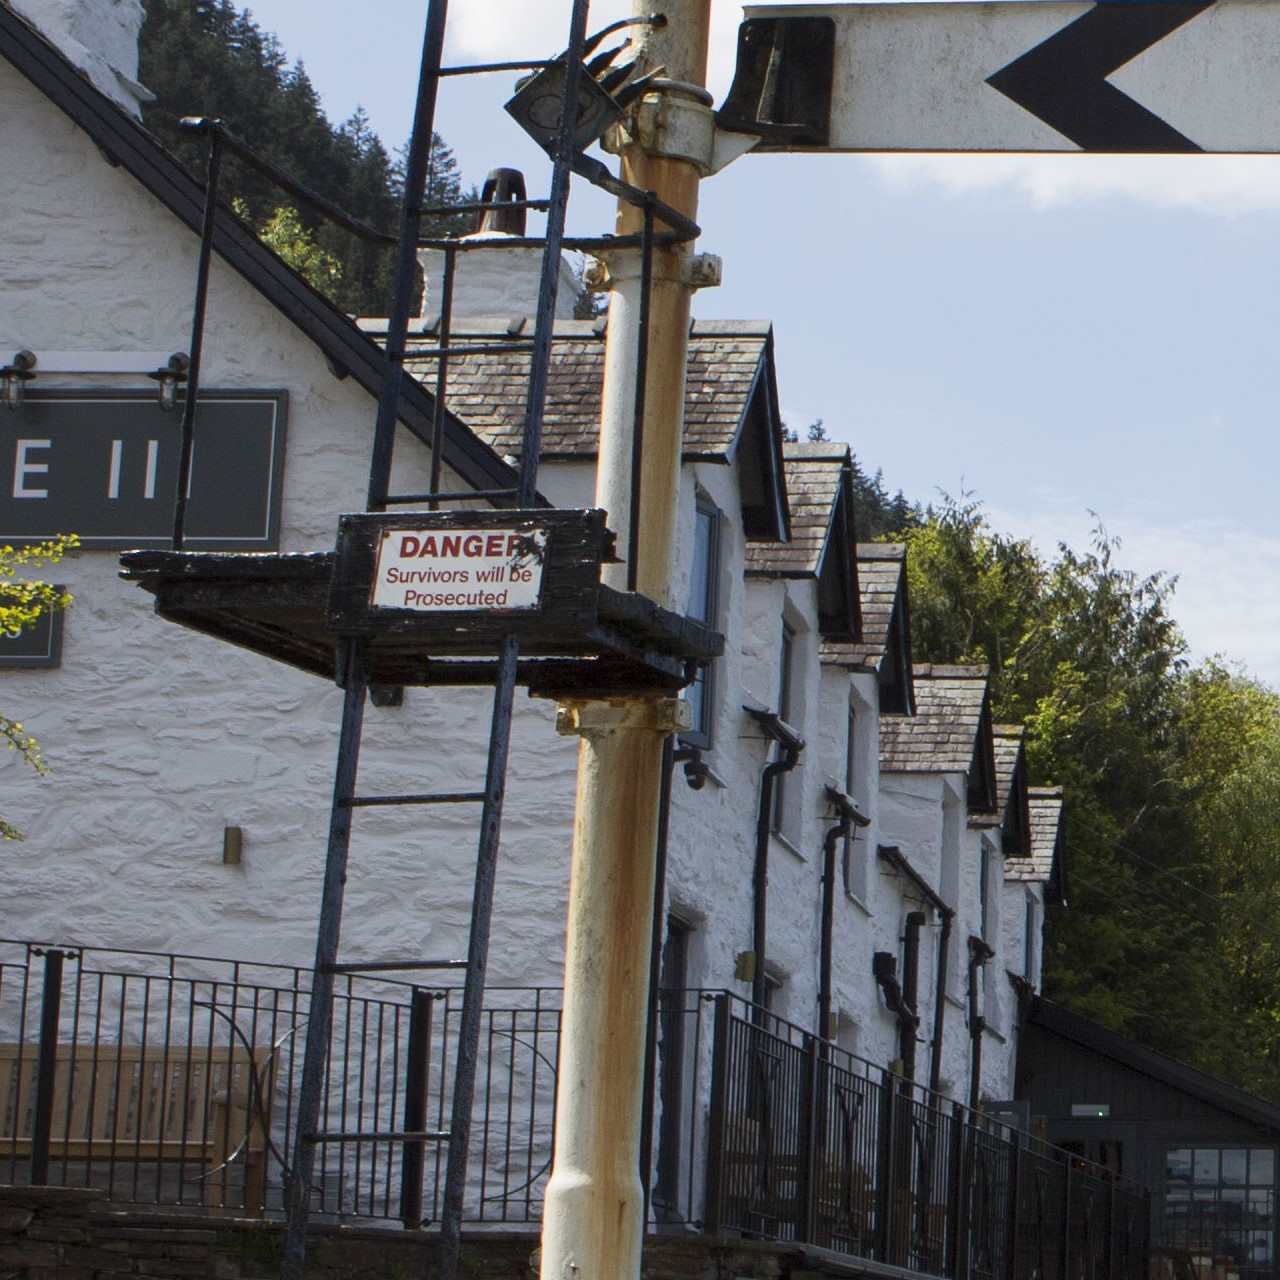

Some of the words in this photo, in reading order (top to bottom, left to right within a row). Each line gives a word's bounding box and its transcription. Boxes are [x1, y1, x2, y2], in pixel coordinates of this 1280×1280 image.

[12, 439, 51, 499] E
[386, 566, 469, 584] Survivors
[475, 566, 505, 583] will
[508, 566, 533, 583] be
[404, 588, 508, 606] Prosecuted
